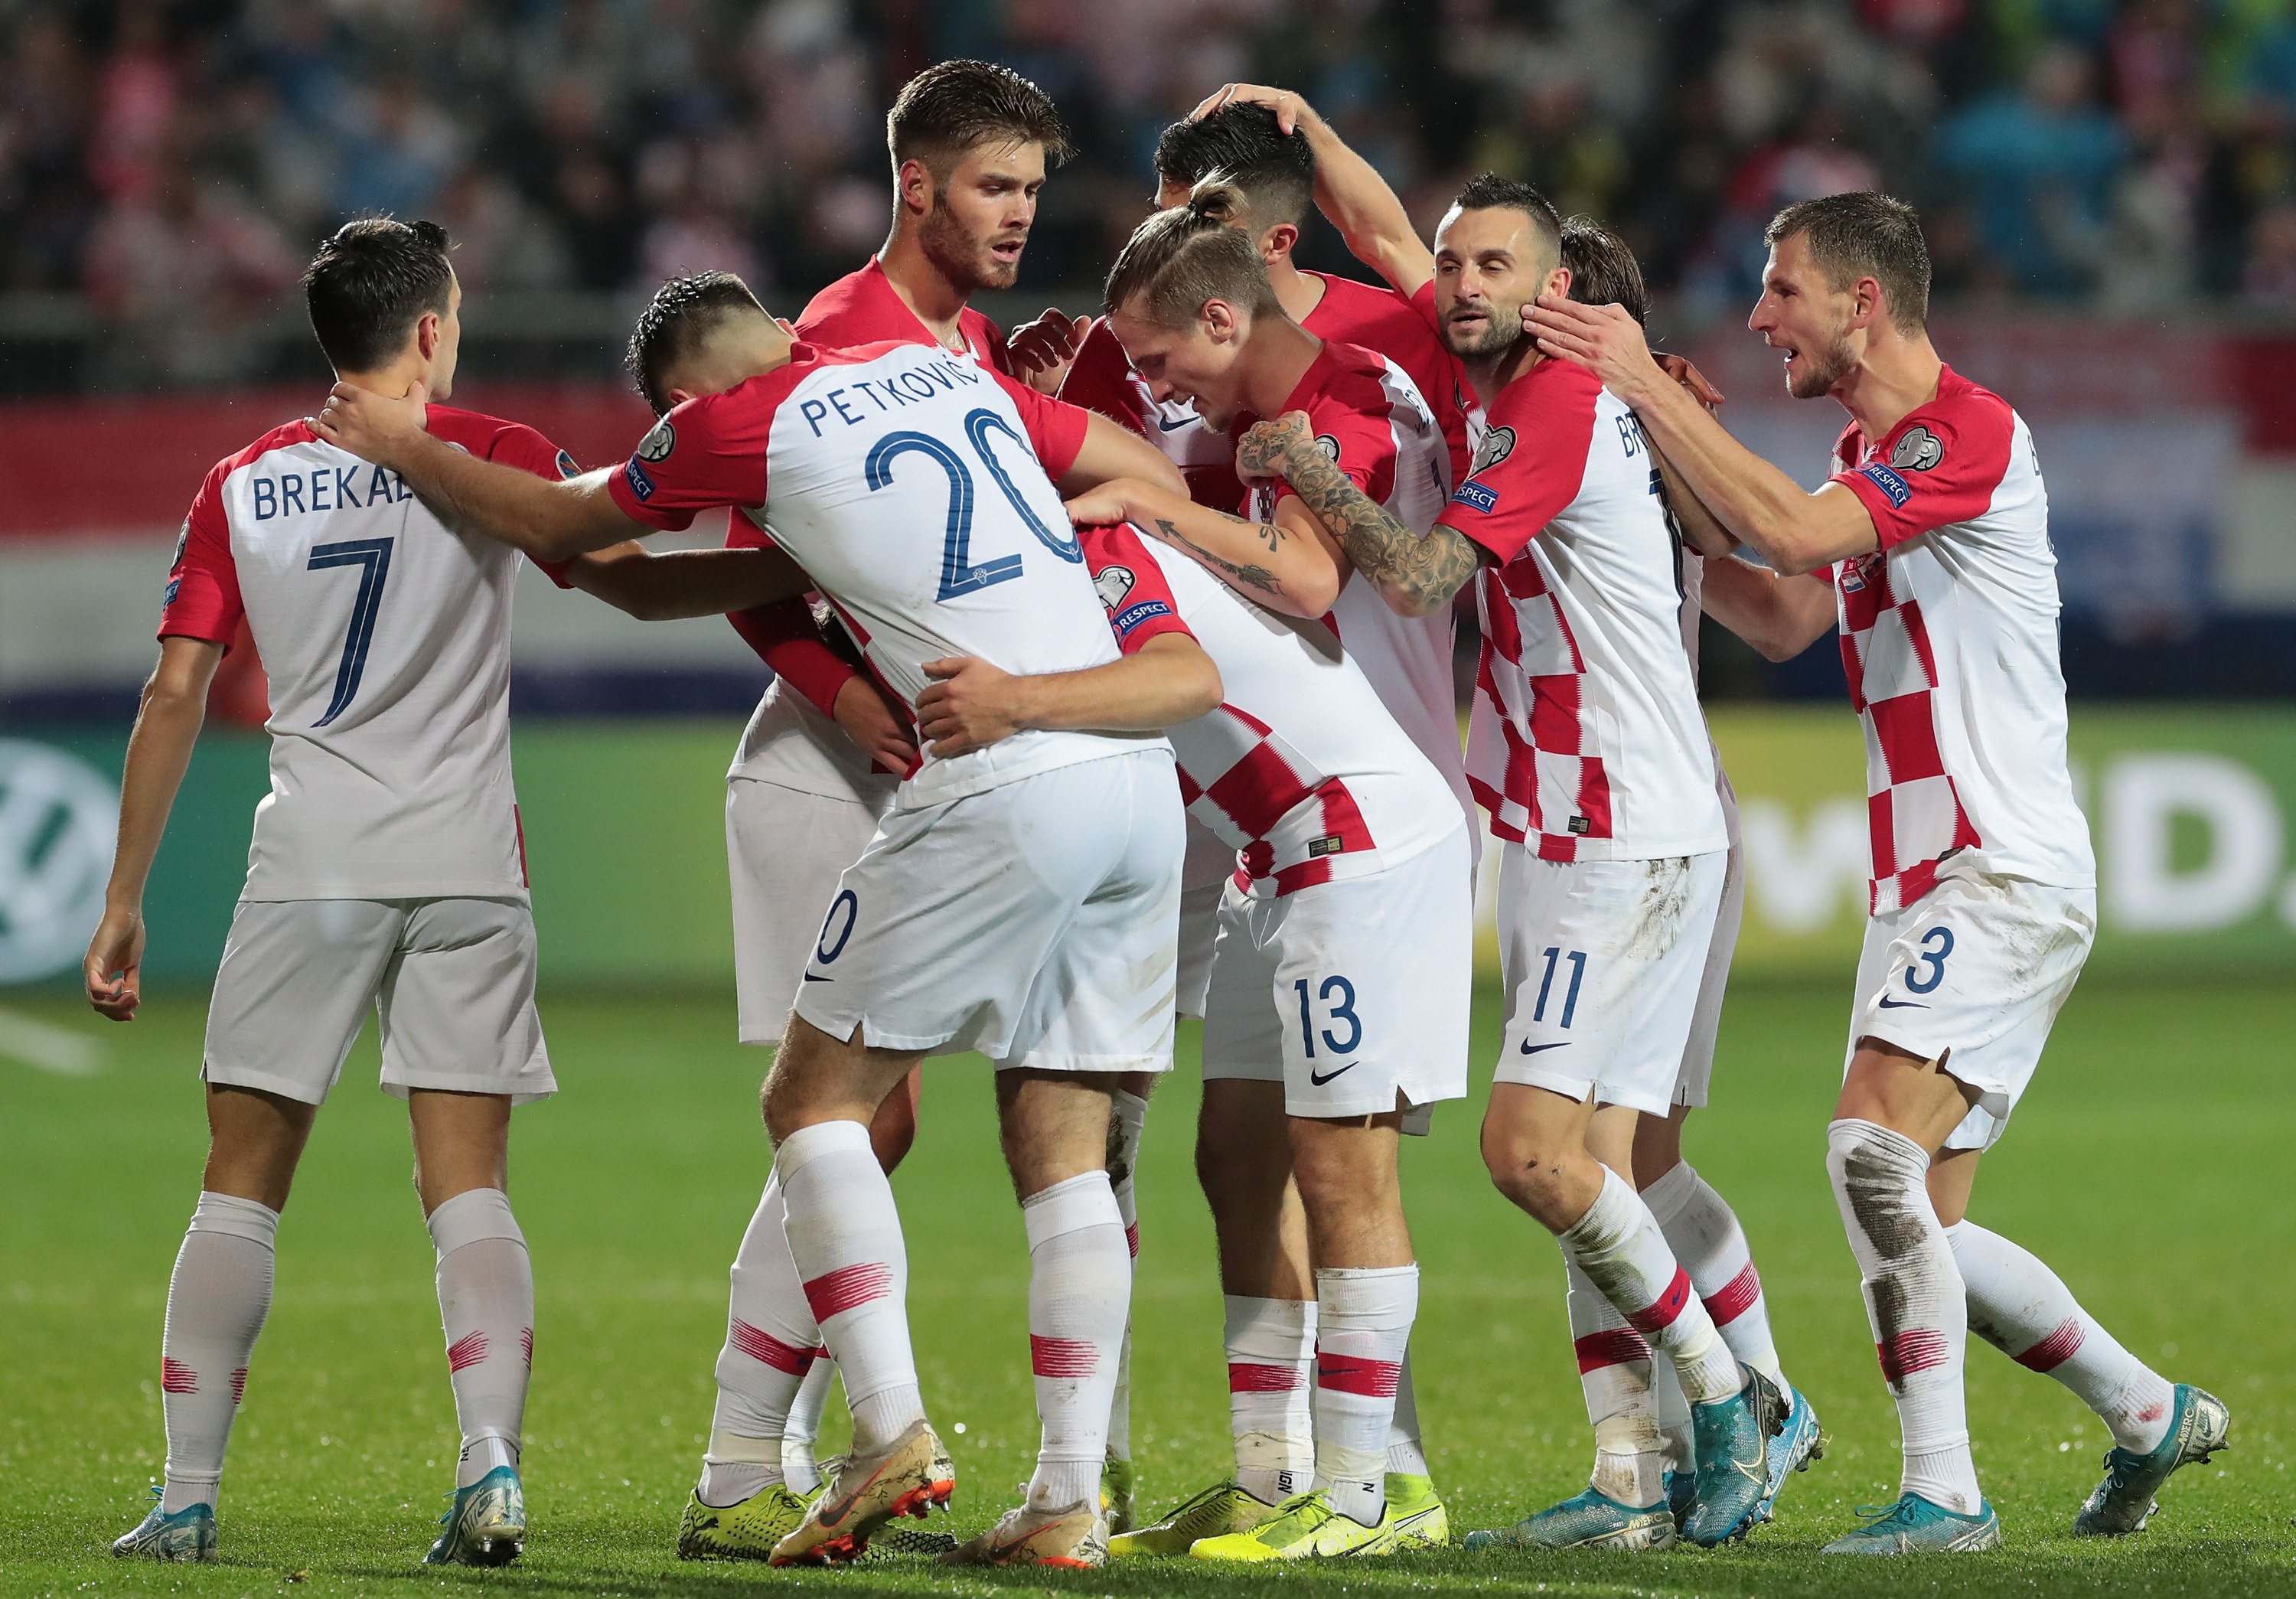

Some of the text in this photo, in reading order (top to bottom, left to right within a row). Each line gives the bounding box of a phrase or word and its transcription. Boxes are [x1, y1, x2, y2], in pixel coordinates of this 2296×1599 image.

[800, 354, 979, 439] PETKOVIĆ
[865, 408, 1084, 603] 20
[1869, 466, 1906, 503] RESPECT
[307, 537, 394, 728] 7
[1119, 603, 1169, 628] RESPECT
[1533, 947, 1587, 1030] 11
[1905, 926, 1955, 994] 3
[1294, 975, 1362, 1059] 13
